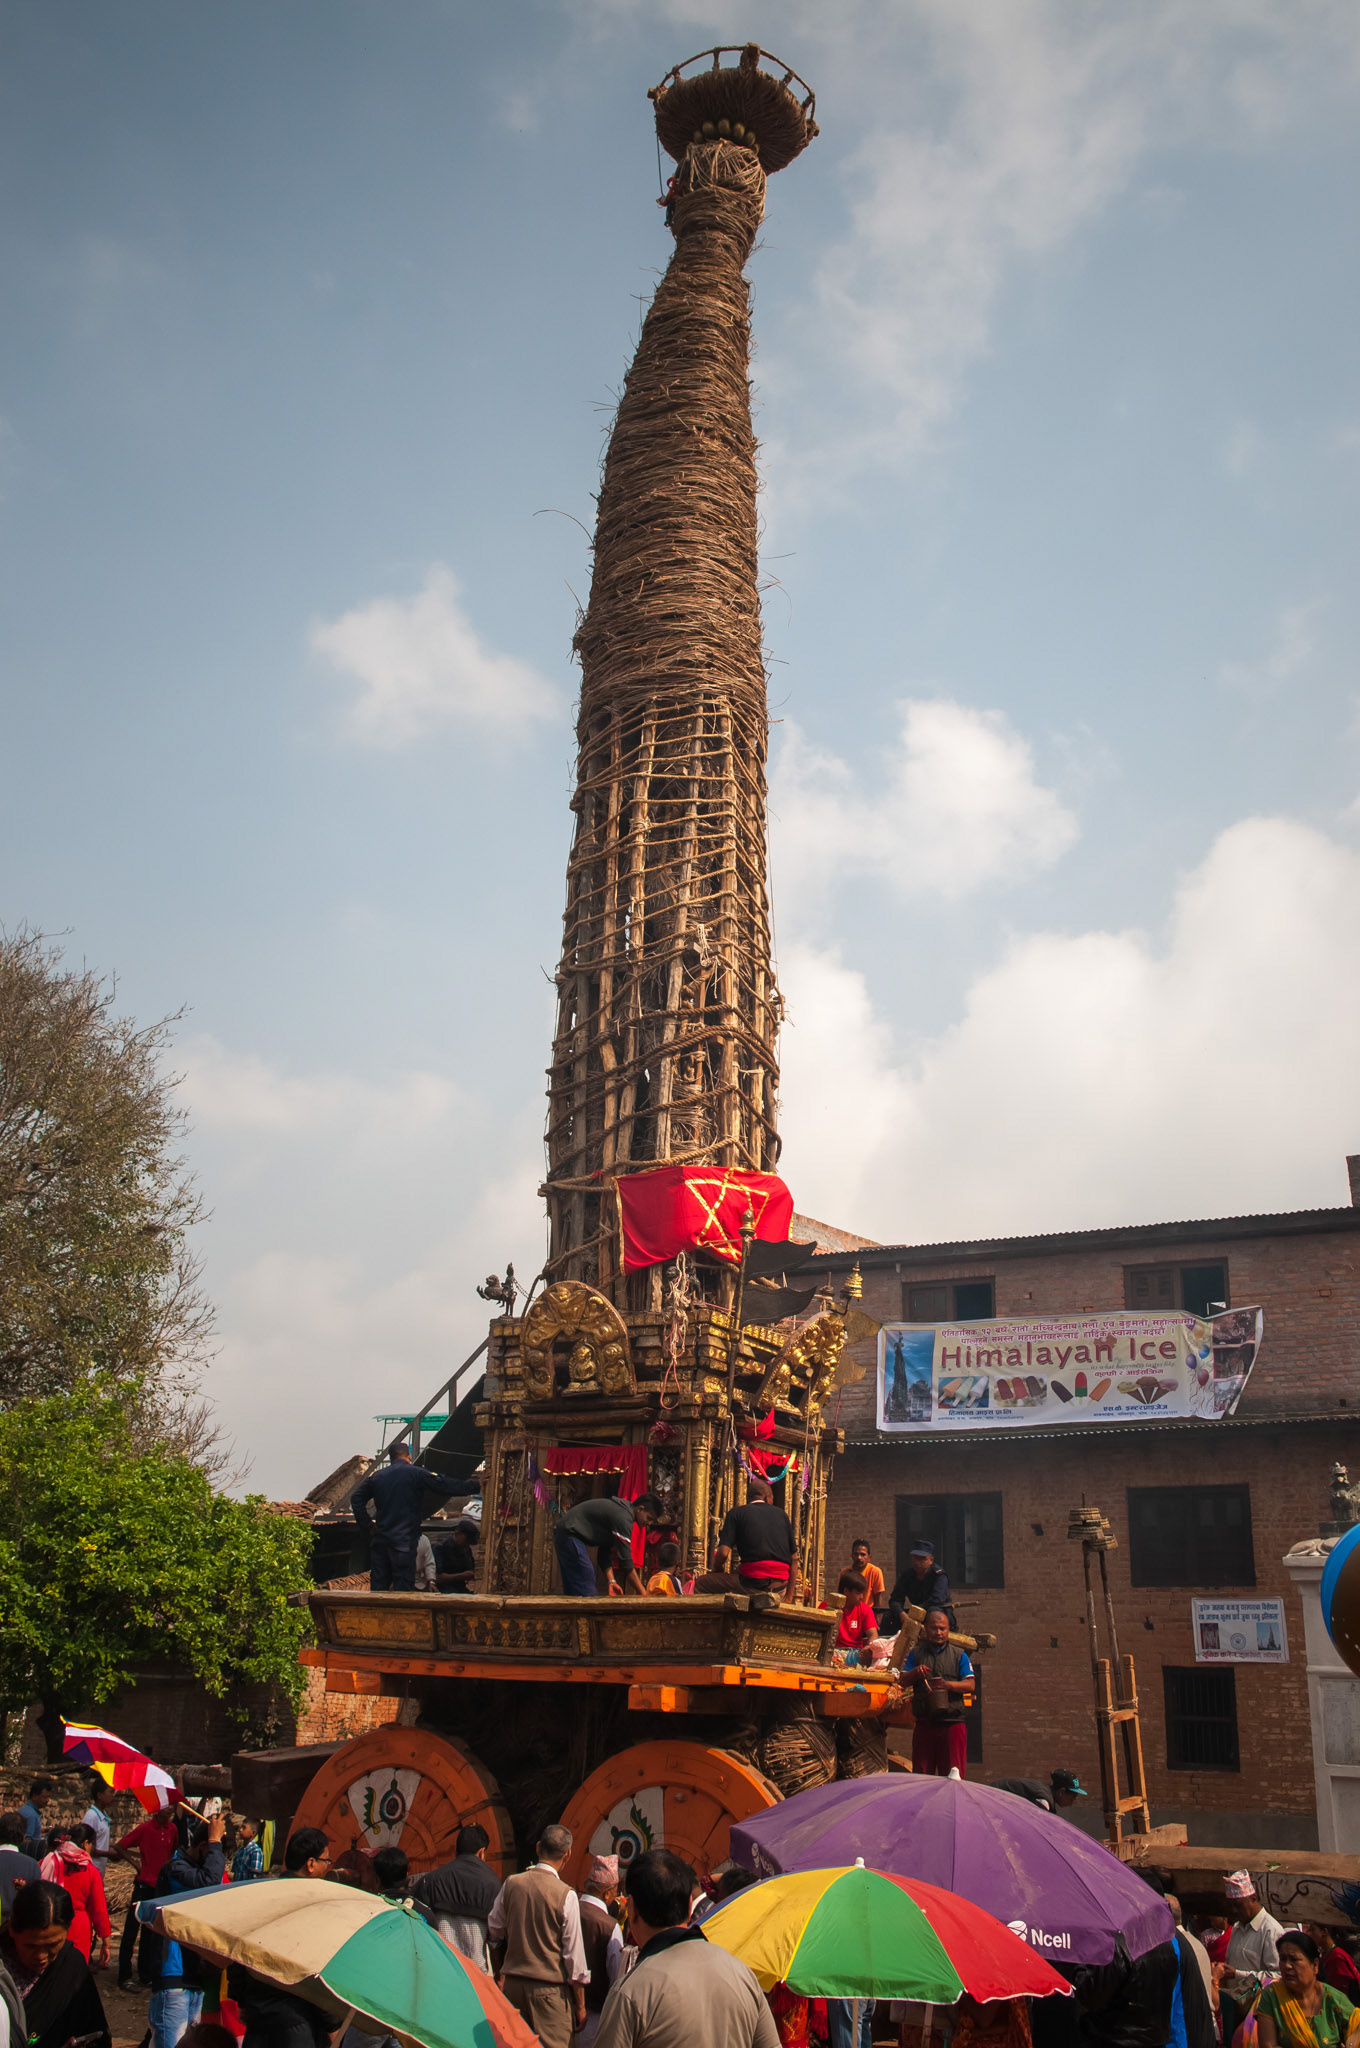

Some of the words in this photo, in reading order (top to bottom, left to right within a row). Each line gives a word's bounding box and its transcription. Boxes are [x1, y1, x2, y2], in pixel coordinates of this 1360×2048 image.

[981, 1327, 991, 1335] १२
[1011, 1324, 1029, 1333] रातो
[1082, 1320, 1098, 1329] मेला
[992, 1335, 1013, 1343] समस्त
[1112, 1328, 1138, 1336] स्वागत
[941, 1341, 1113, 1369] Himalayan
[1130, 1338, 1177, 1360] Ice
[1031, 1928, 1071, 1950] Ncell
